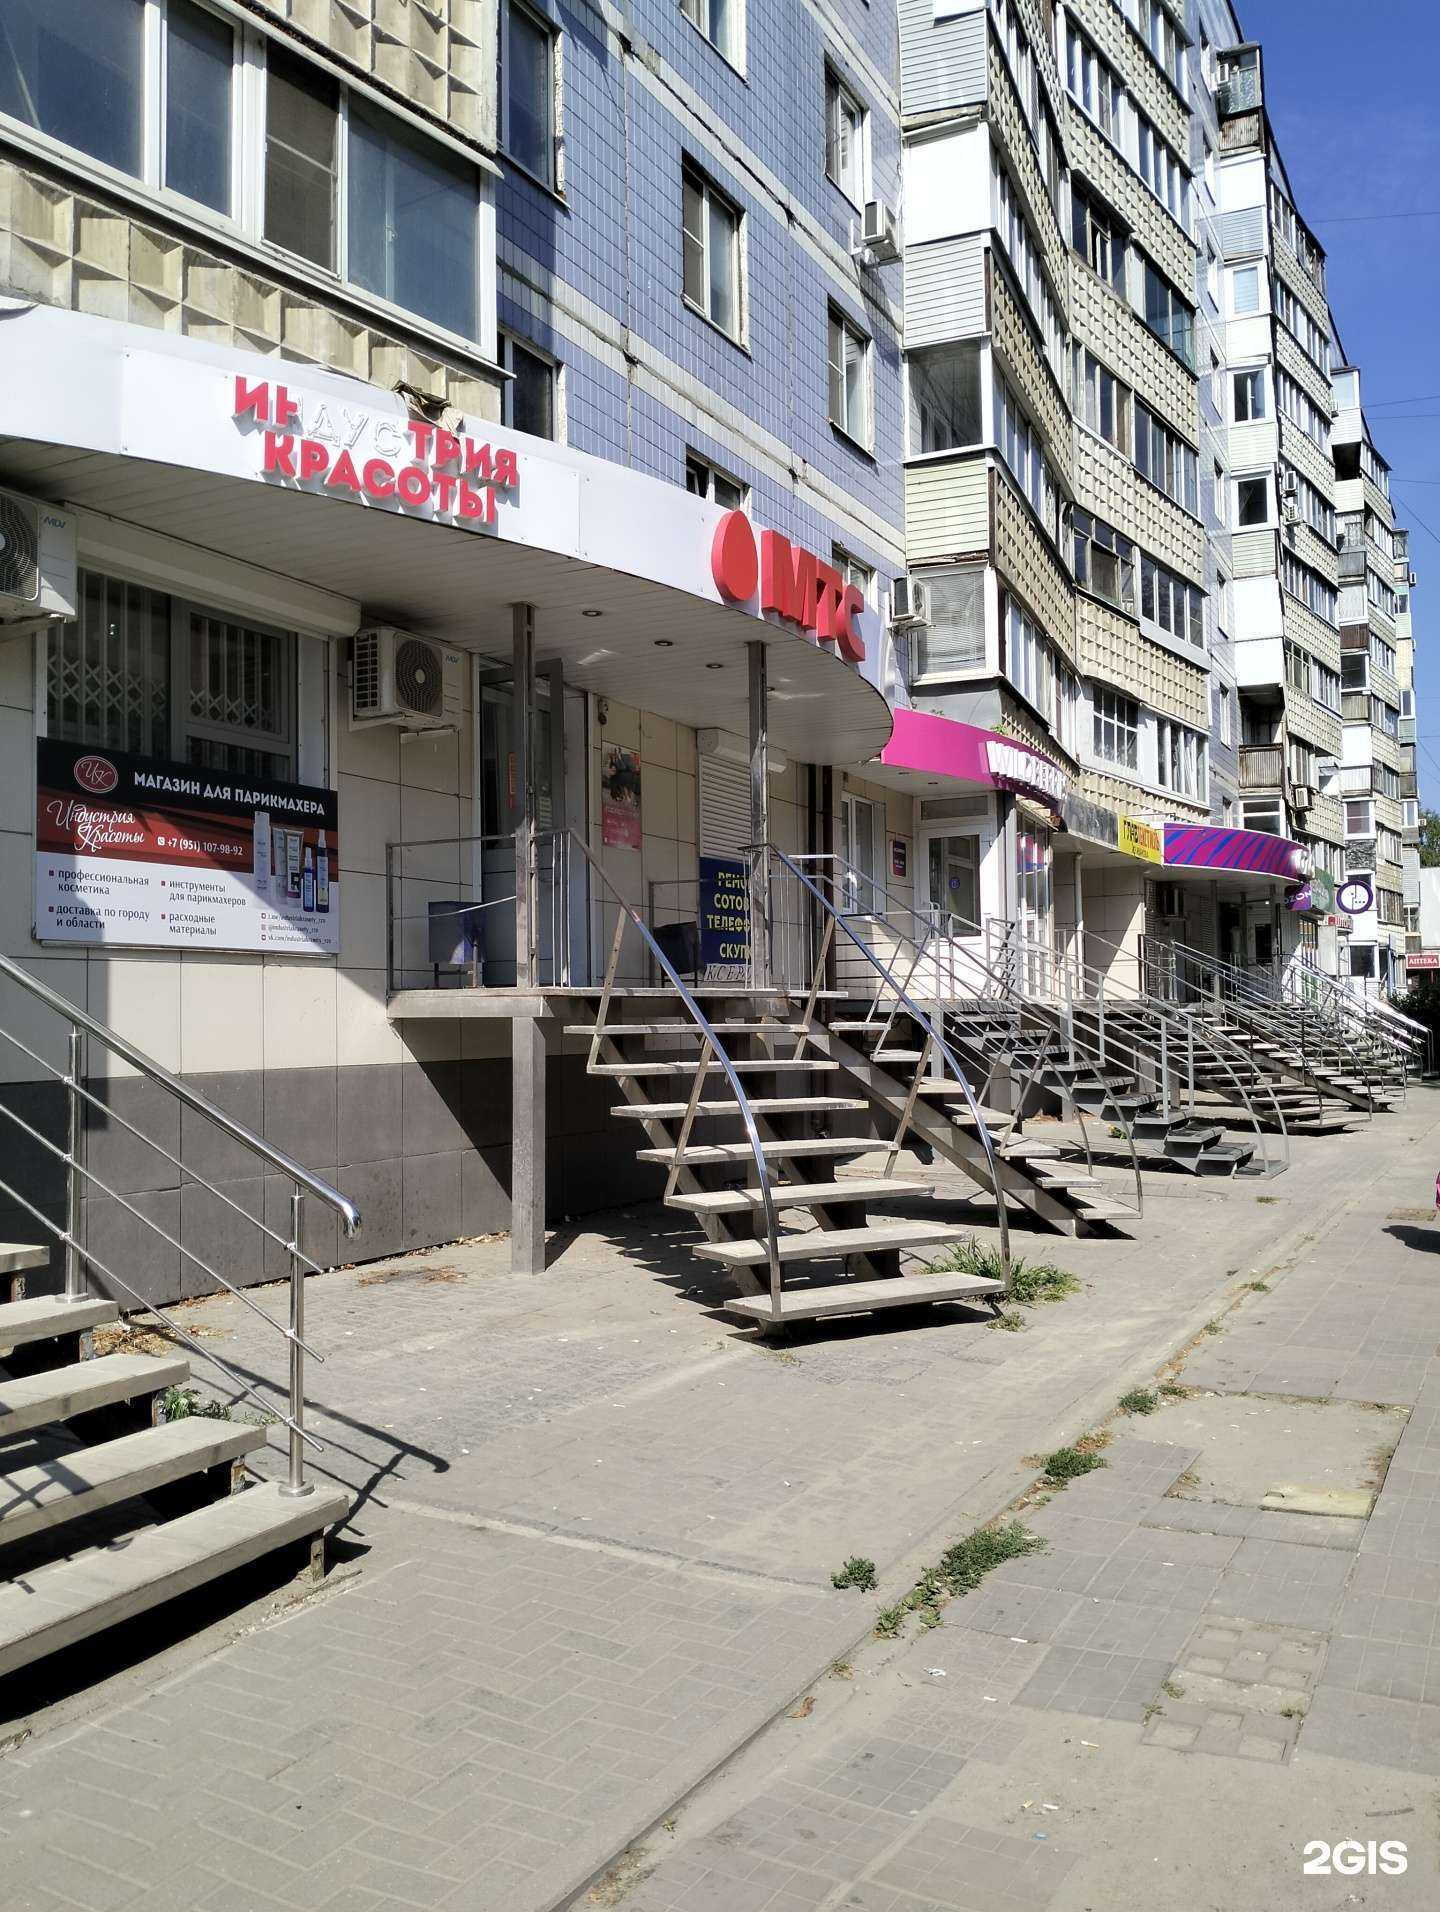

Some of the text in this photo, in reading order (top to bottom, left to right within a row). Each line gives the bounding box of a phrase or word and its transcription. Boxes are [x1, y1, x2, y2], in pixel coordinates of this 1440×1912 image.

[235, 376, 518, 488] ИНДУСТРИЯ
[264, 429, 497, 526] КРАСОТЫ
[761, 529, 866, 662] МТС
[134, 771, 325, 816] МАГАЗИН ДЛЯ ПАРИКМАХЕРА
[47, 800, 136, 832] Индустрия
[74, 822, 145, 852] Красоты
[167, 838, 177, 848] +7
[179, 837, 201, 853] (951)
[203, 841, 244, 856] 107-98-92
[58, 869, 149, 886] профессиональная
[169, 880, 226, 893] инструменты
[718, 871, 748, 890] РЕМО
[58, 882, 110, 895] косметика
[169, 892, 247, 908] для парикмахеров
[713, 893, 750, 912] СОТОВ
[56, 904, 150, 922] доставка по городу
[56, 916, 105, 929] и области
[169, 913, 216, 925] расходные
[169, 925, 217, 938] материалы
[706, 914, 751, 933] ТЕЛЕФО
[719, 943, 752, 960] СКУПК
